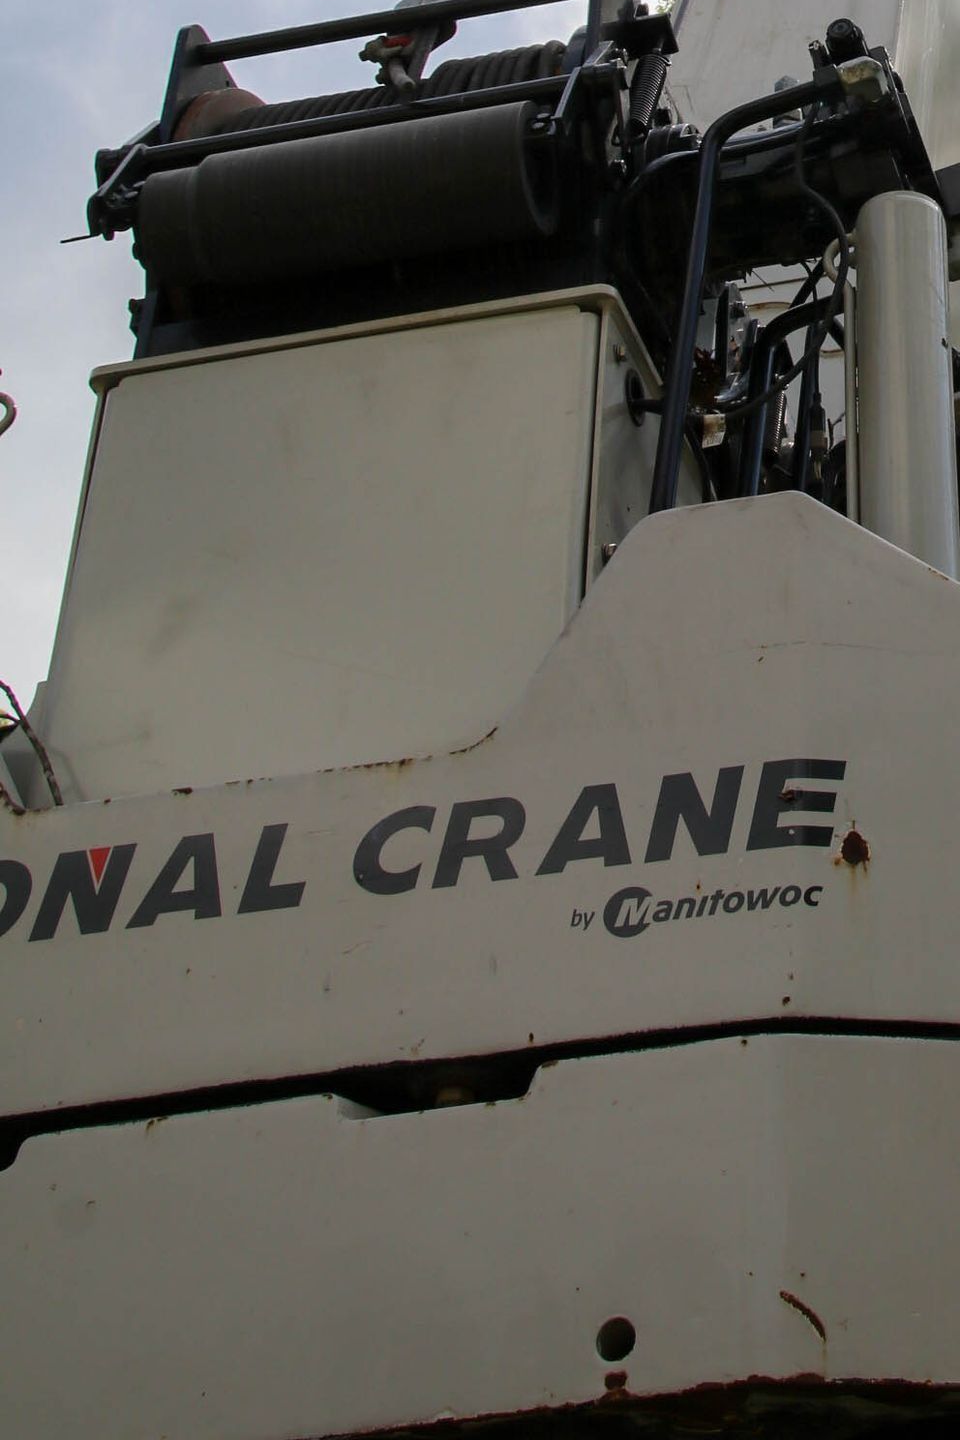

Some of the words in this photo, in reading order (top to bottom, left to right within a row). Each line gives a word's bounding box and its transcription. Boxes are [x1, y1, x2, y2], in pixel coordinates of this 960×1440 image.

[352, 759, 847, 895] CRANE
[570, 909, 595, 930] by
[604, 885, 823, 937] Manitowoc
